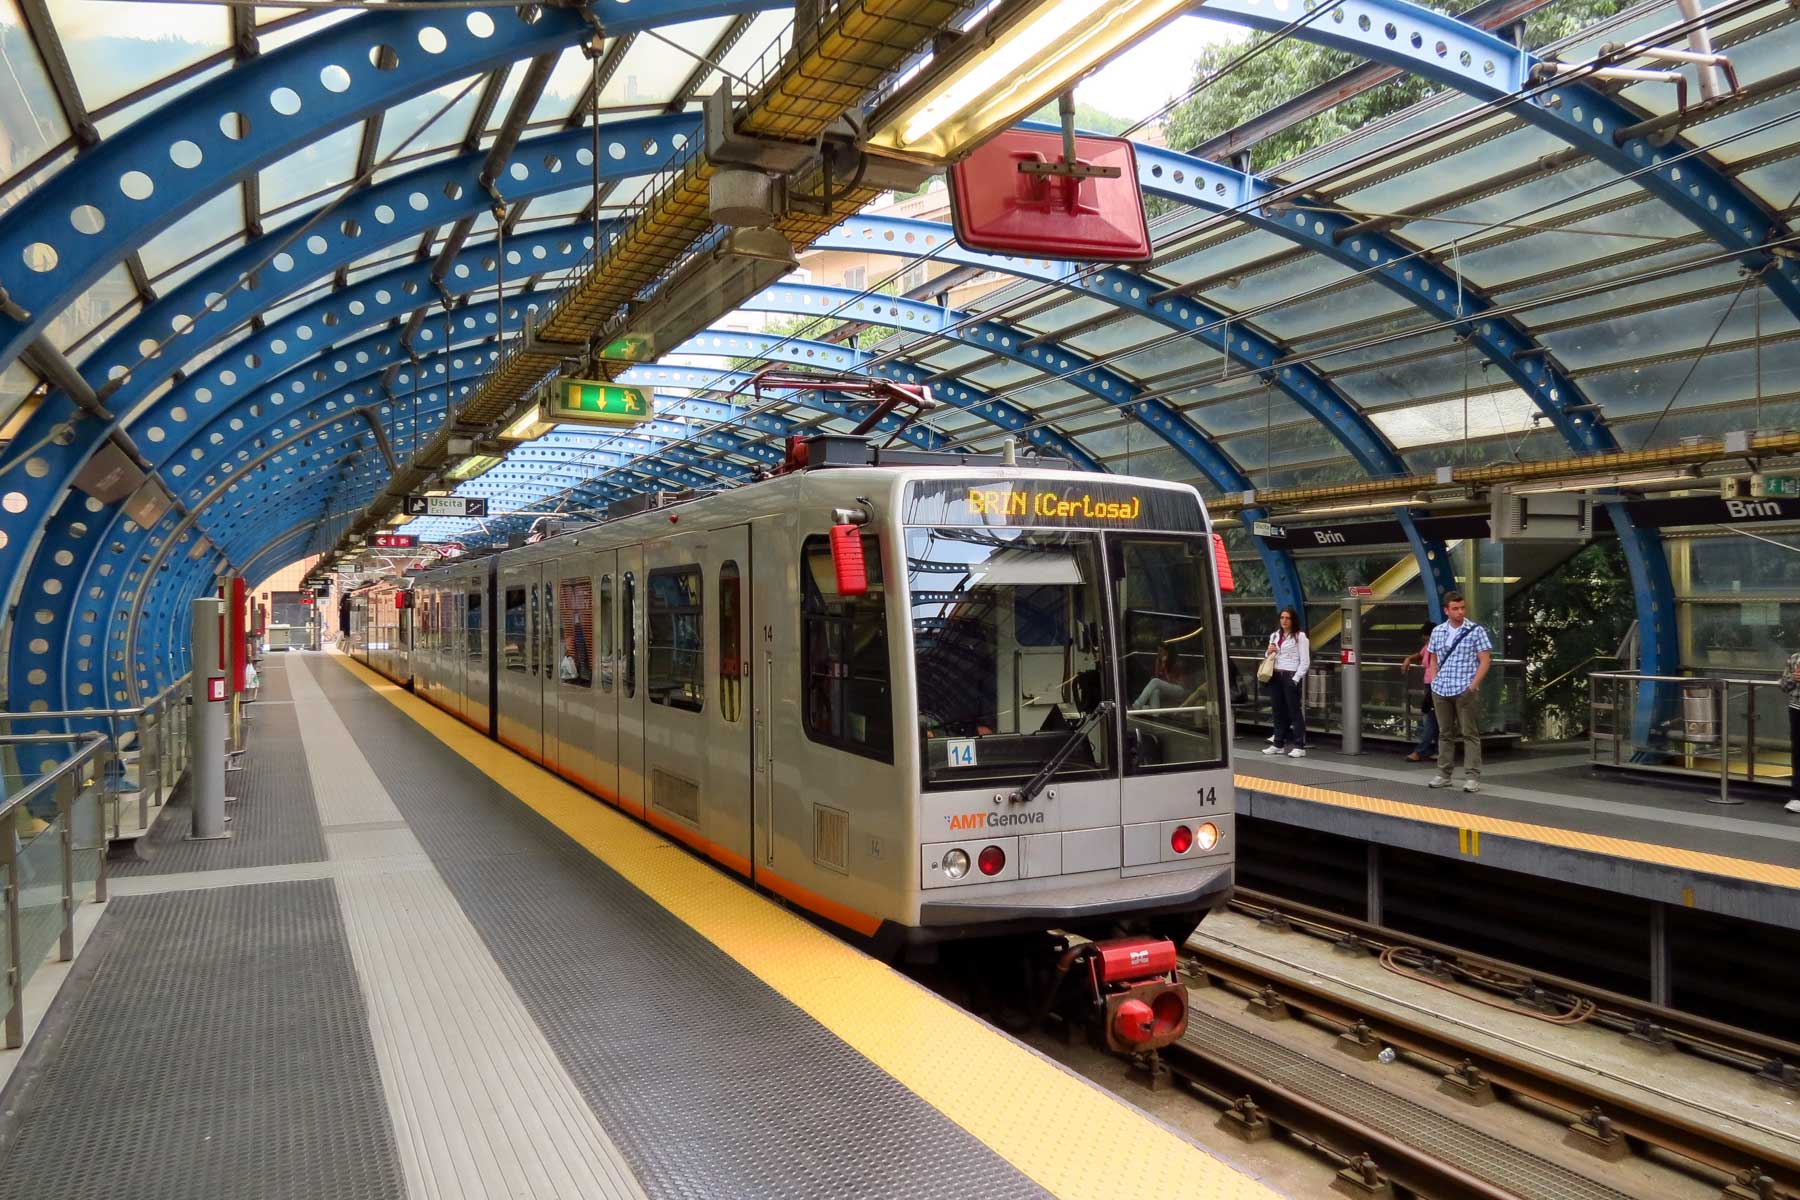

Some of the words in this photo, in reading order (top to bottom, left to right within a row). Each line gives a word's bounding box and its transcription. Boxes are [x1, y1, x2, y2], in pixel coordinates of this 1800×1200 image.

[430, 499, 463, 508] Uscita
[968, 490, 1027, 515] BRIN
[1725, 500, 1781, 518] Brin
[1313, 530, 1346, 544] Brin
[763, 624, 773, 642] 14
[951, 745, 973, 765] 14
[1197, 786, 1217, 807] 14
